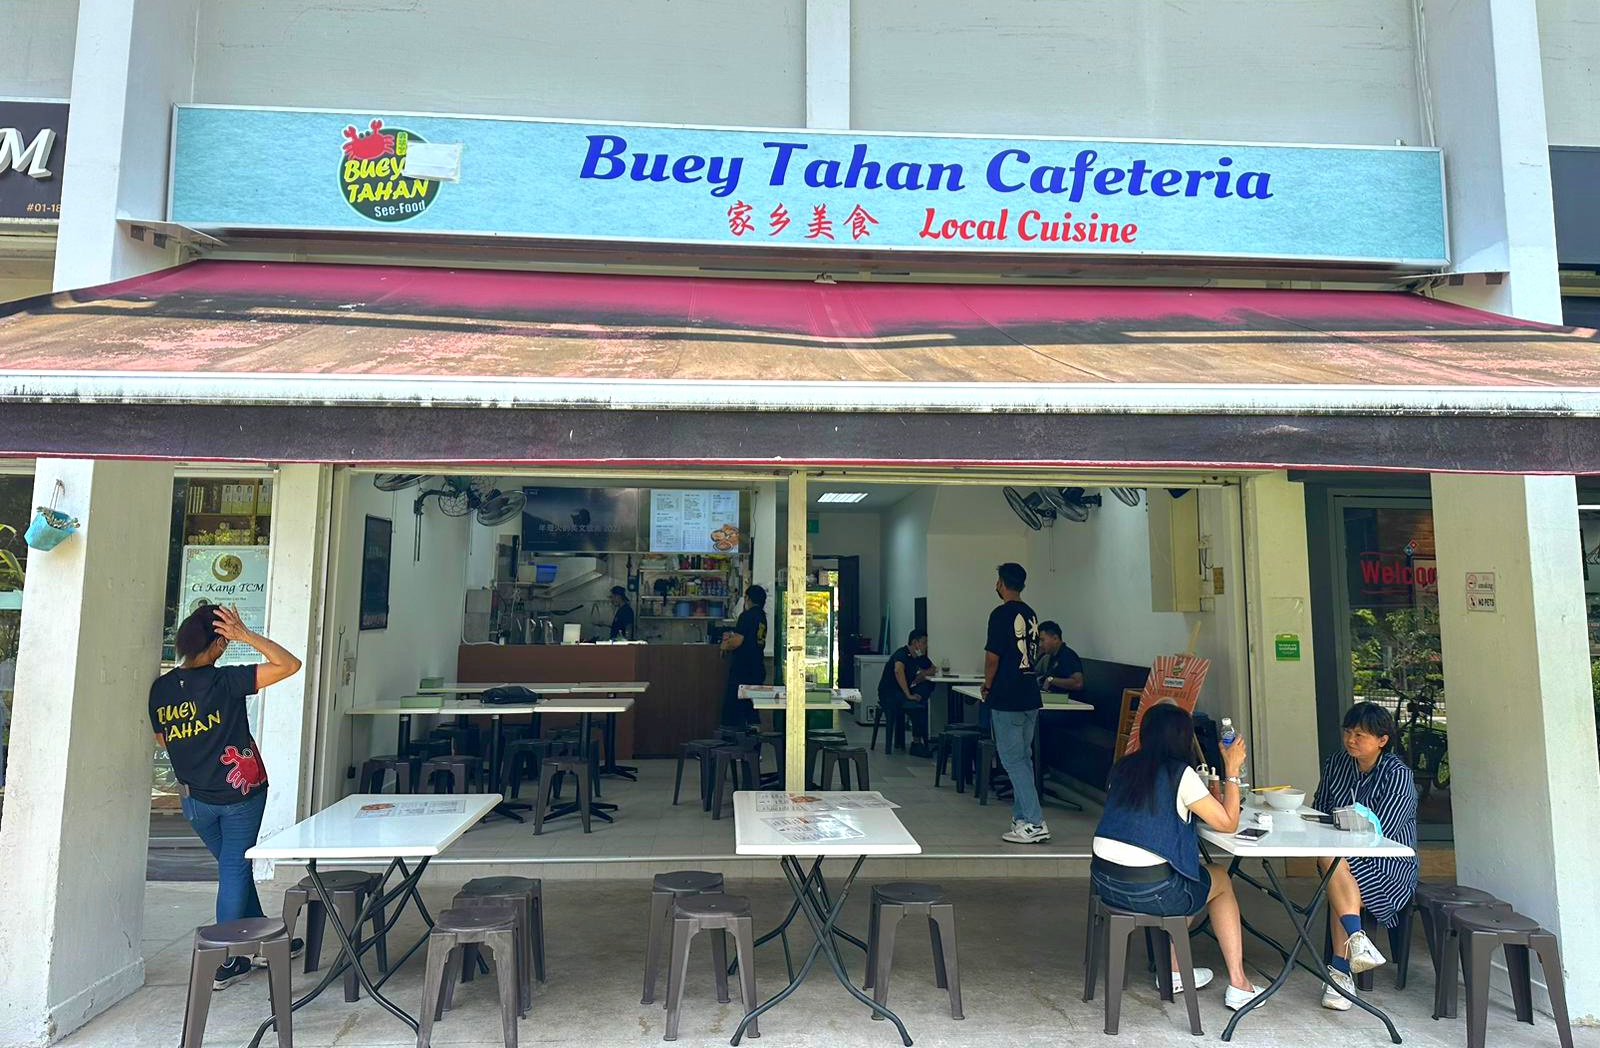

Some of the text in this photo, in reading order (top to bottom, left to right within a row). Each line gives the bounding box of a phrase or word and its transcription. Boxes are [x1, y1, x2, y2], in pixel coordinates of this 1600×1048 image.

[580, 136, 1273, 202] Buey Tahan Cafeteria
[348, 179, 429, 203] TAHAN
[374, 200, 426, 217] See-Food
[726, 200, 879, 240] 家乡美食
[919, 208, 1138, 244] Local Cuisine
[191, 583, 264, 594] Ci Kang TCM
